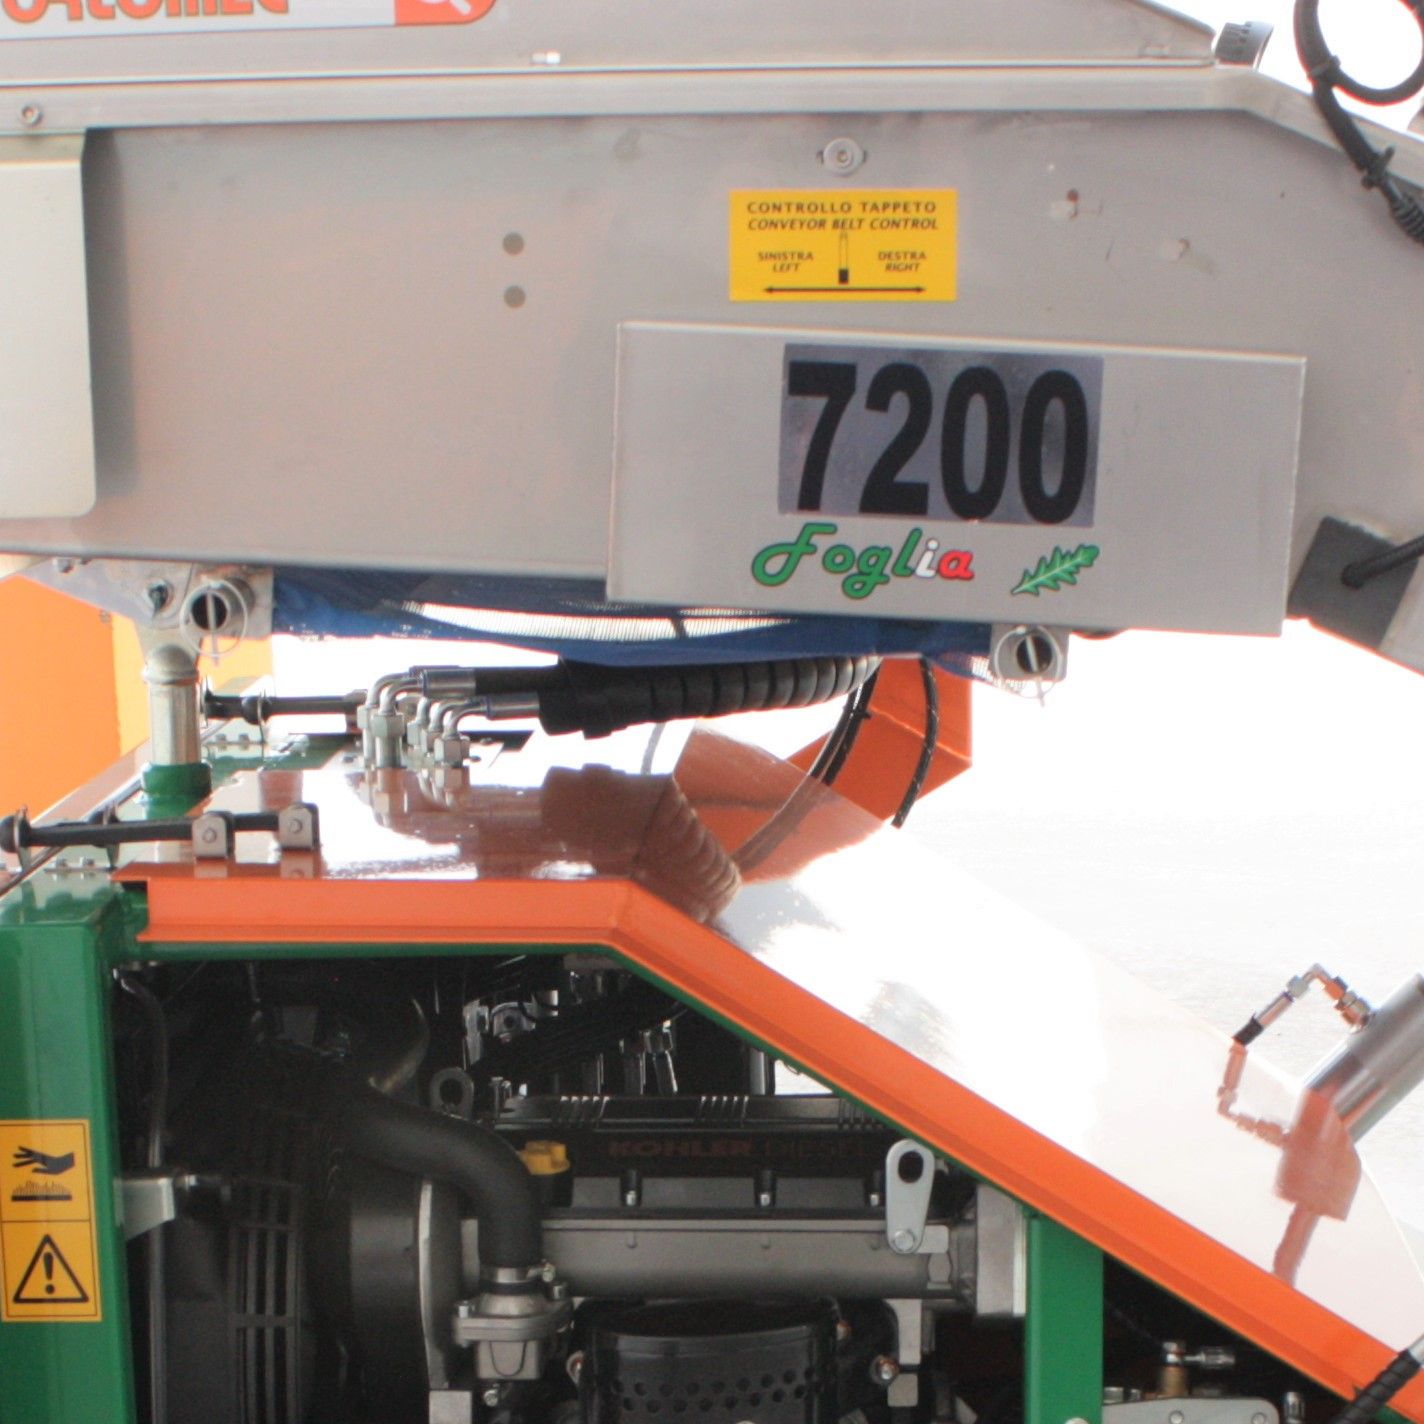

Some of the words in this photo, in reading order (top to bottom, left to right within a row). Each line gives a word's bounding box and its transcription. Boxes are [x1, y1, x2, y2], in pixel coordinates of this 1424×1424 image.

[747, 201, 852, 214] CONTROLLO
[860, 201, 937, 214] TAPPETO
[748, 217, 827, 230] CONVEYOR
[832, 218, 864, 230] BELT
[869, 218, 939, 230] CONTROL
[758, 251, 814, 261] SINISTRA
[878, 251, 926, 260] DESTRA
[772, 263, 801, 272] LEFT
[885, 263, 920, 271] RIGHT
[788, 360, 1089, 524] 7200
[751, 522, 974, 599] Foglia
